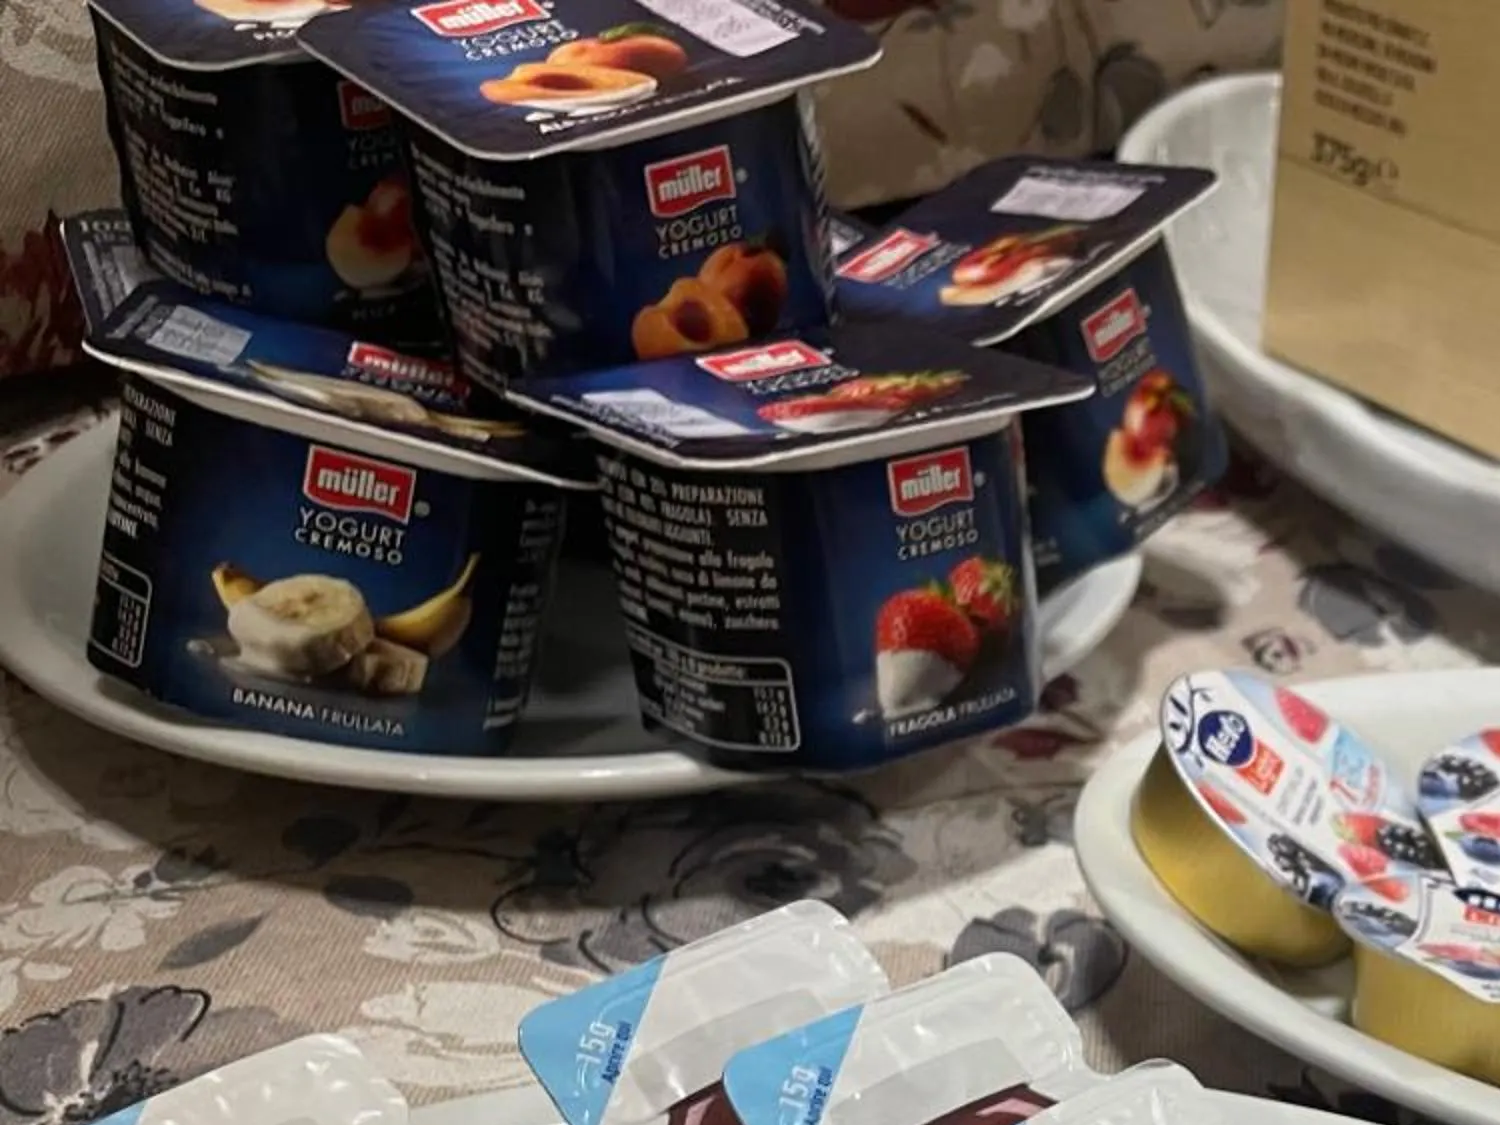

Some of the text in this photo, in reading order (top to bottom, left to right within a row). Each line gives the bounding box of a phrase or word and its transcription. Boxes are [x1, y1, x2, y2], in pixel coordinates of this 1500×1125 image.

[658, 164, 722, 203] müller
[655, 203, 737, 242] YOGURT
[658, 224, 743, 260] CREMOSO
[316, 466, 401, 508] müller
[901, 463, 962, 502] müller
[300, 505, 407, 550] YOGURT
[895, 507, 975, 544] YOGURT
[897, 528, 980, 562] CREMOSO
[294, 526, 404, 566] CREMOSO
[232, 686, 406, 738] BANANA FRULLATA
[889, 705, 958, 738] FRAGOLA
[575, 1021, 617, 1065] 15g
[602, 1044, 625, 1085] Aprire
[779, 1066, 818, 1109] 15g
